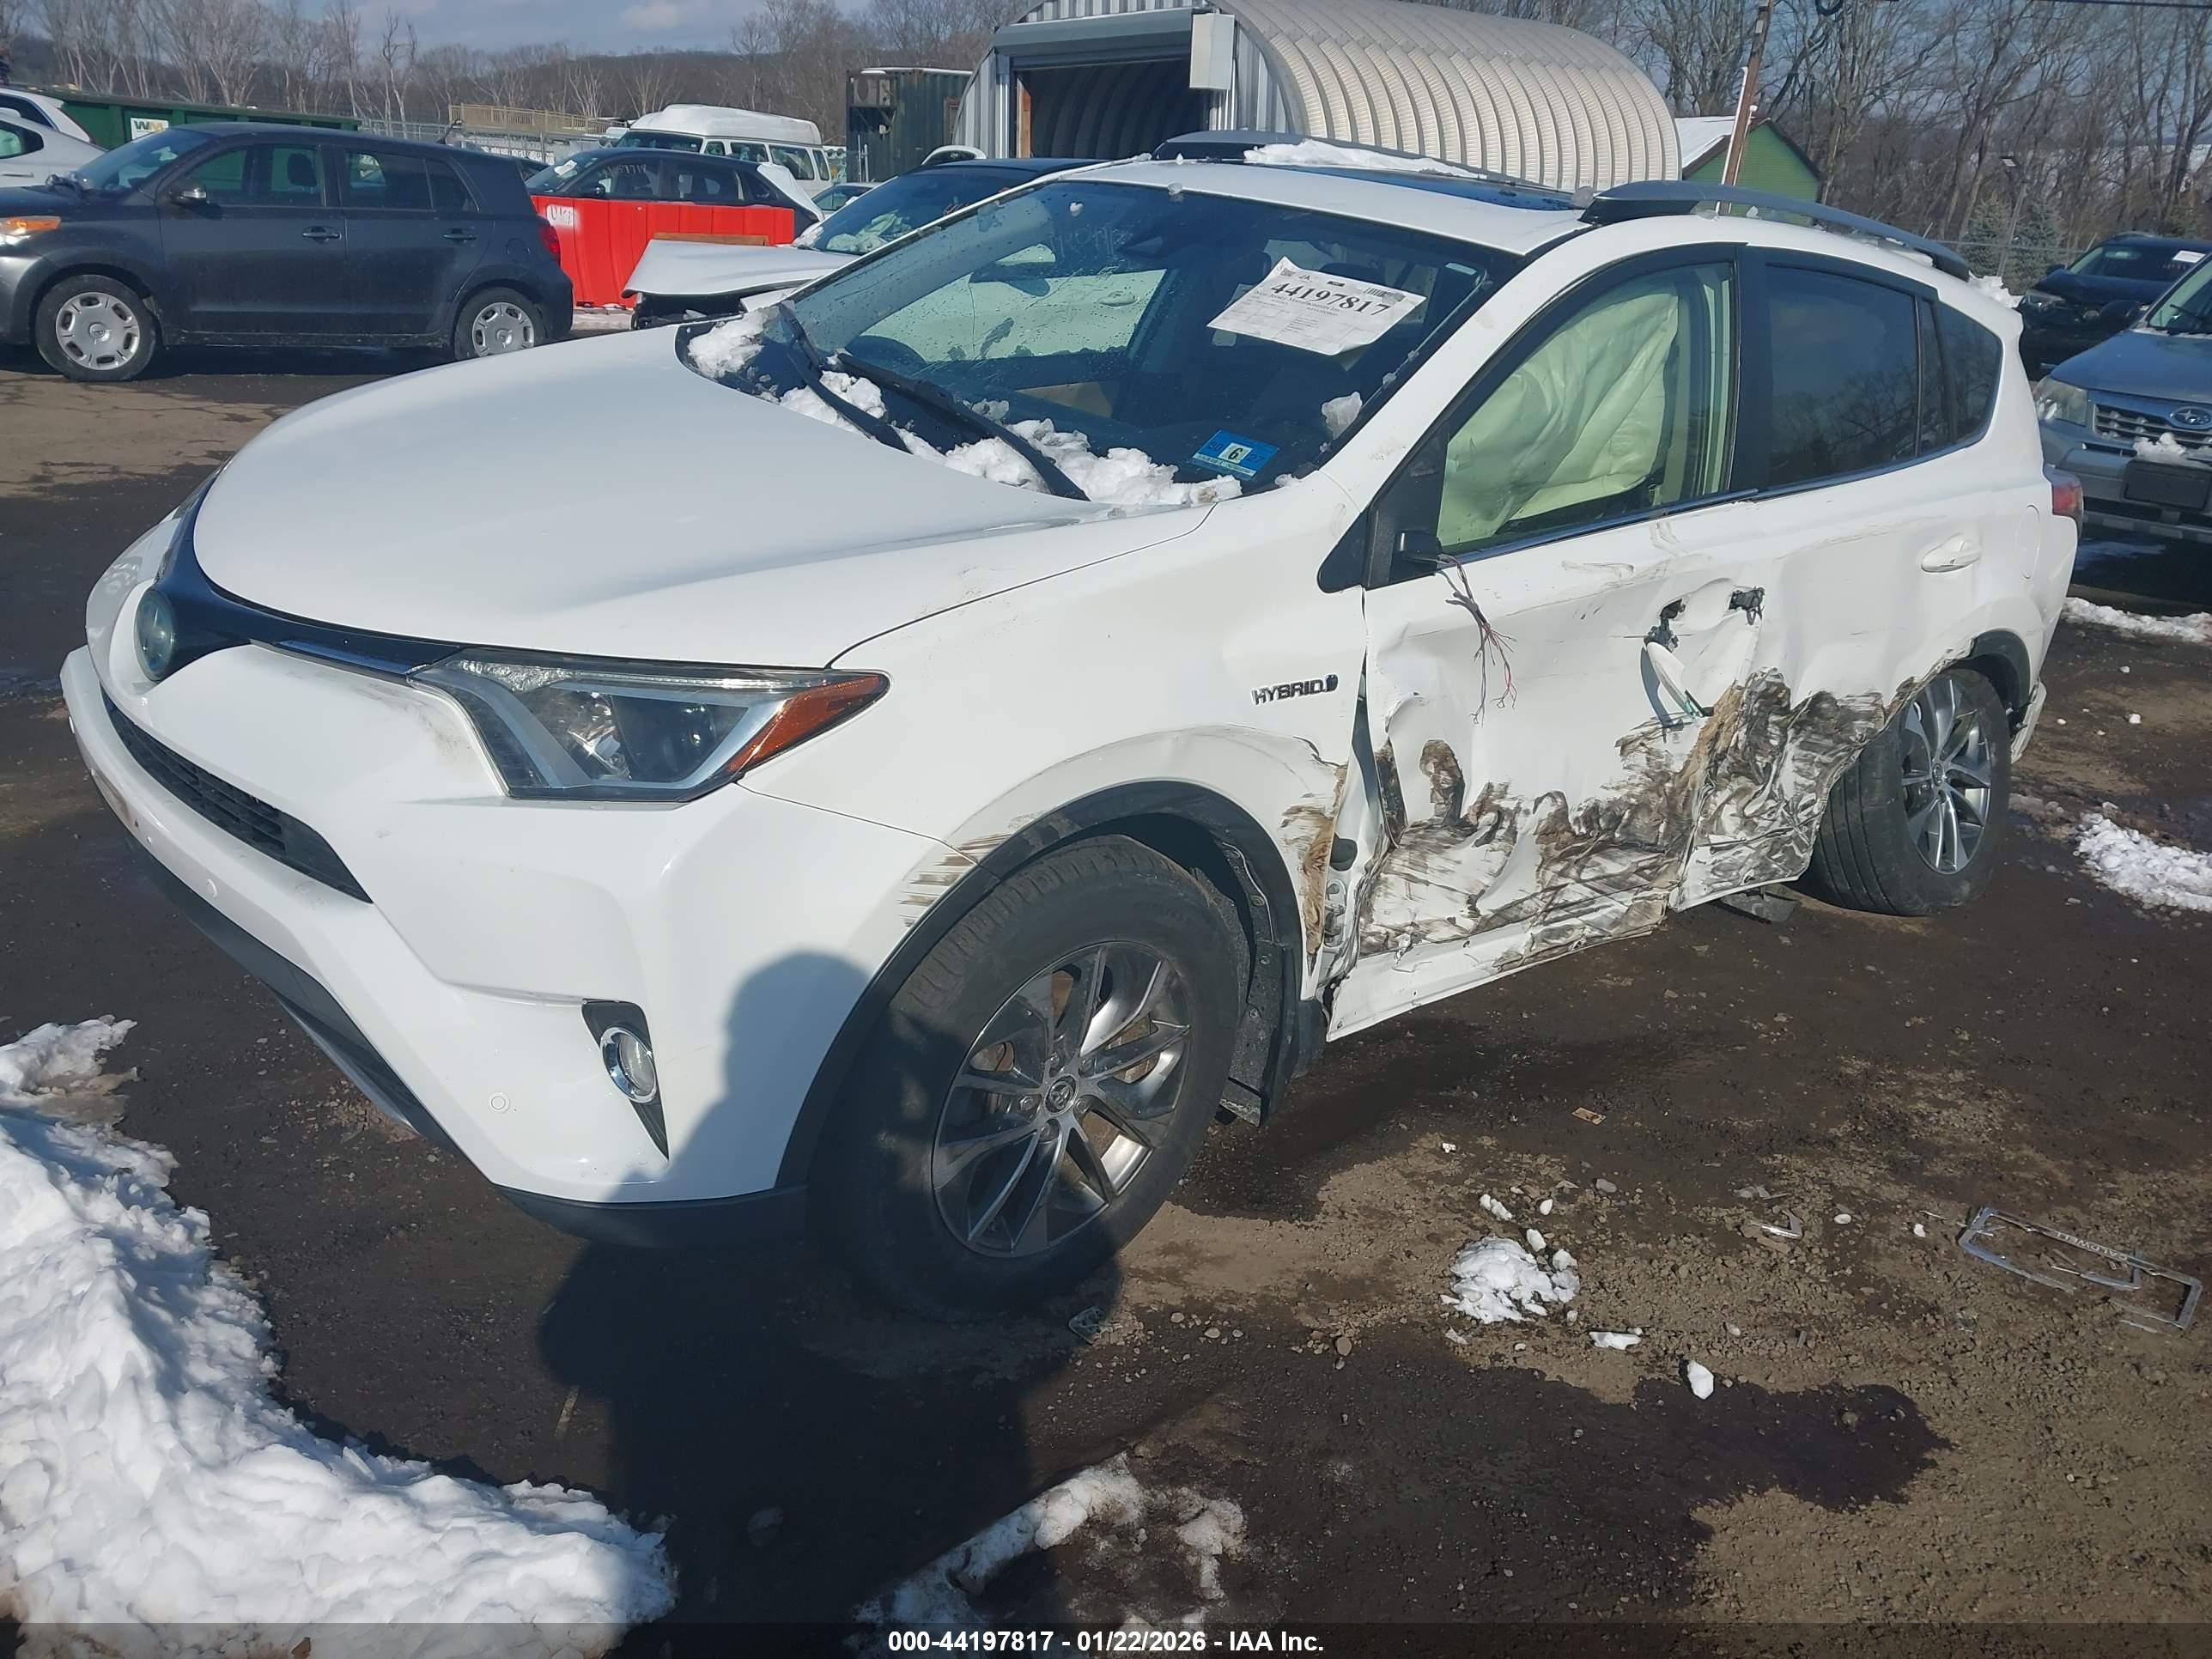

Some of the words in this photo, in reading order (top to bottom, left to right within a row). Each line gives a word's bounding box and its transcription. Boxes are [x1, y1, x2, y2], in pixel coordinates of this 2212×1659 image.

[133, 120, 164, 131] WM
[1271, 283, 1392, 315] 44197817
[1228, 447, 1243, 459] 6
[1252, 678, 1324, 705] HYBRID
[2057, 1231, 2128, 1261] CALDWELL
